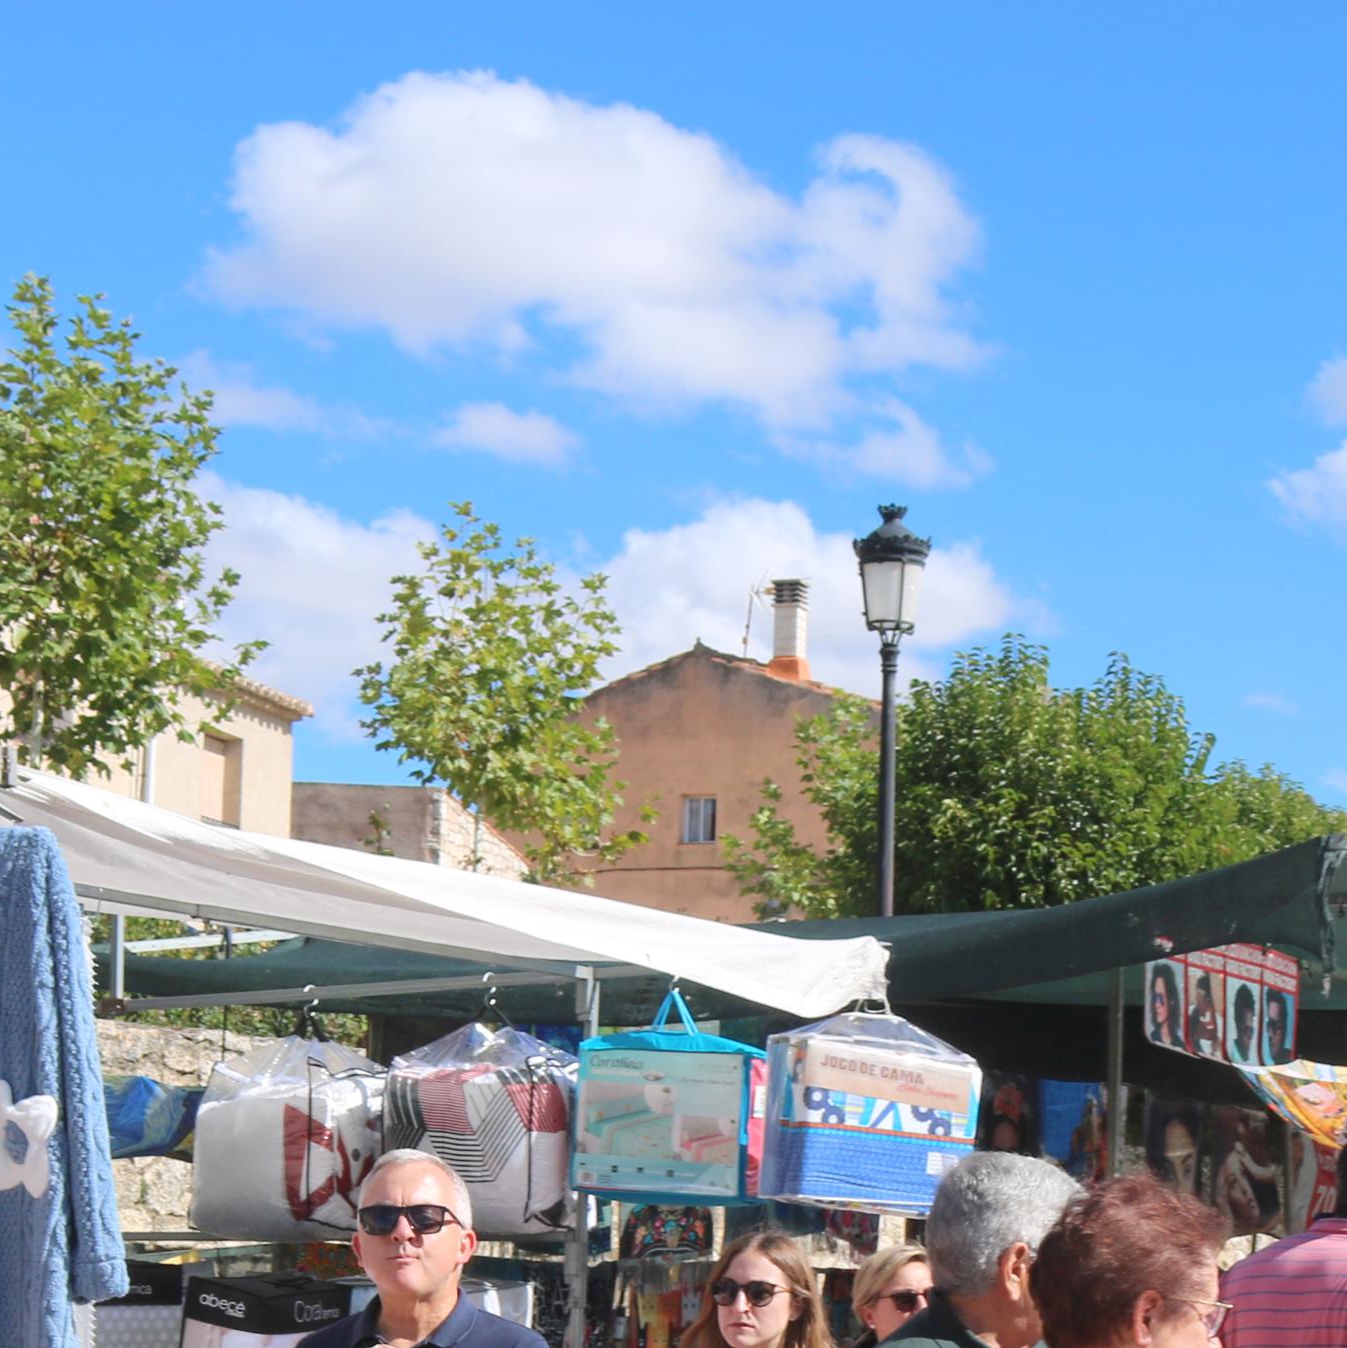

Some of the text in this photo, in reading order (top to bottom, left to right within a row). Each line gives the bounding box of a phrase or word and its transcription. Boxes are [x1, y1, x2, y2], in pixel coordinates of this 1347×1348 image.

[859, 1061, 877, 1077] DE
[880, 1066, 925, 1086] CAMA
[199, 1291, 247, 1313] abecé
